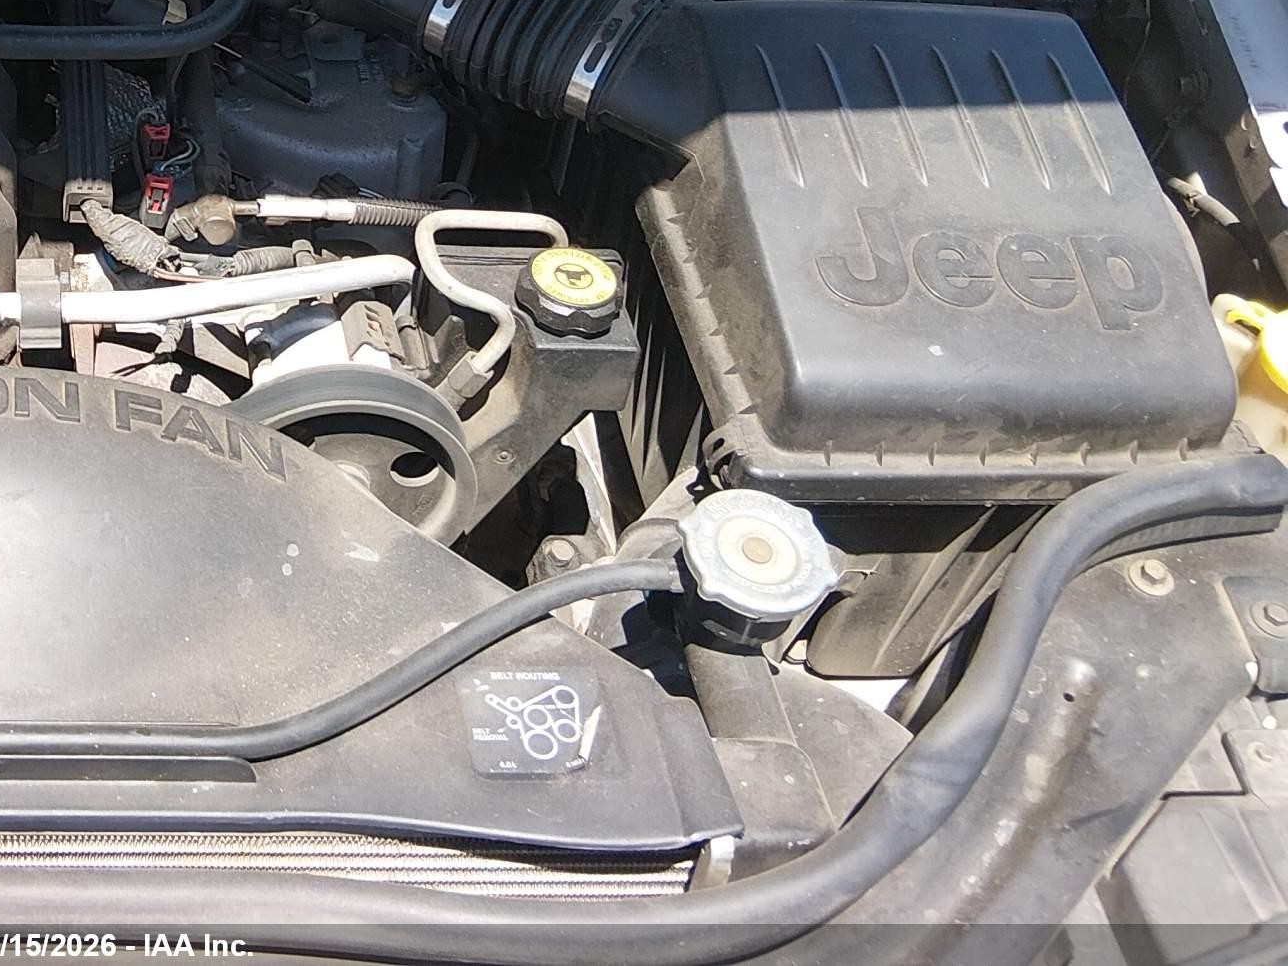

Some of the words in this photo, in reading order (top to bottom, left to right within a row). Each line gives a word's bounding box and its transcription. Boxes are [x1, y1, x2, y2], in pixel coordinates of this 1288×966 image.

[815, 206, 1165, 331] Jeep
[113, 389, 288, 483] FAN
[490, 671, 513, 681] BELT
[515, 671, 561, 681] ROUTING
